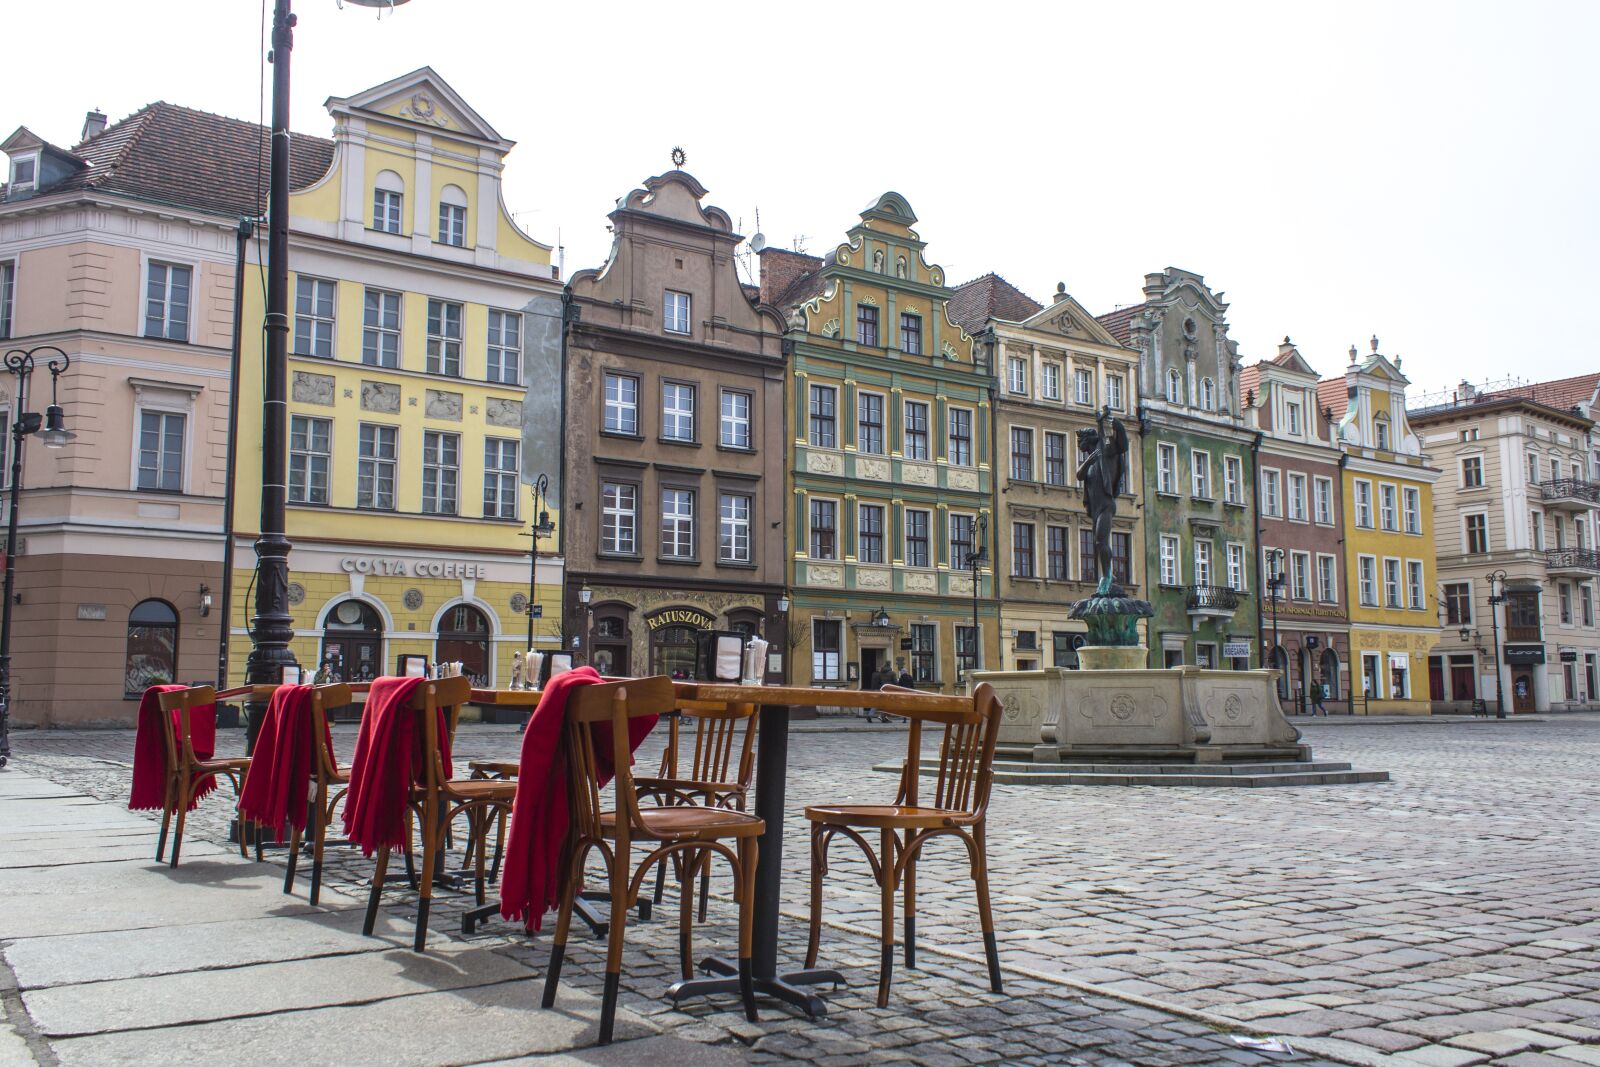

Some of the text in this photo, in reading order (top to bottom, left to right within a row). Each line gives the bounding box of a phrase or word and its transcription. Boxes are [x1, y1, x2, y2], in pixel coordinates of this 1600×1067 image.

[341, 556, 485, 579] COSTA COFFEE
[647, 610, 713, 630] RATUSZOVA
